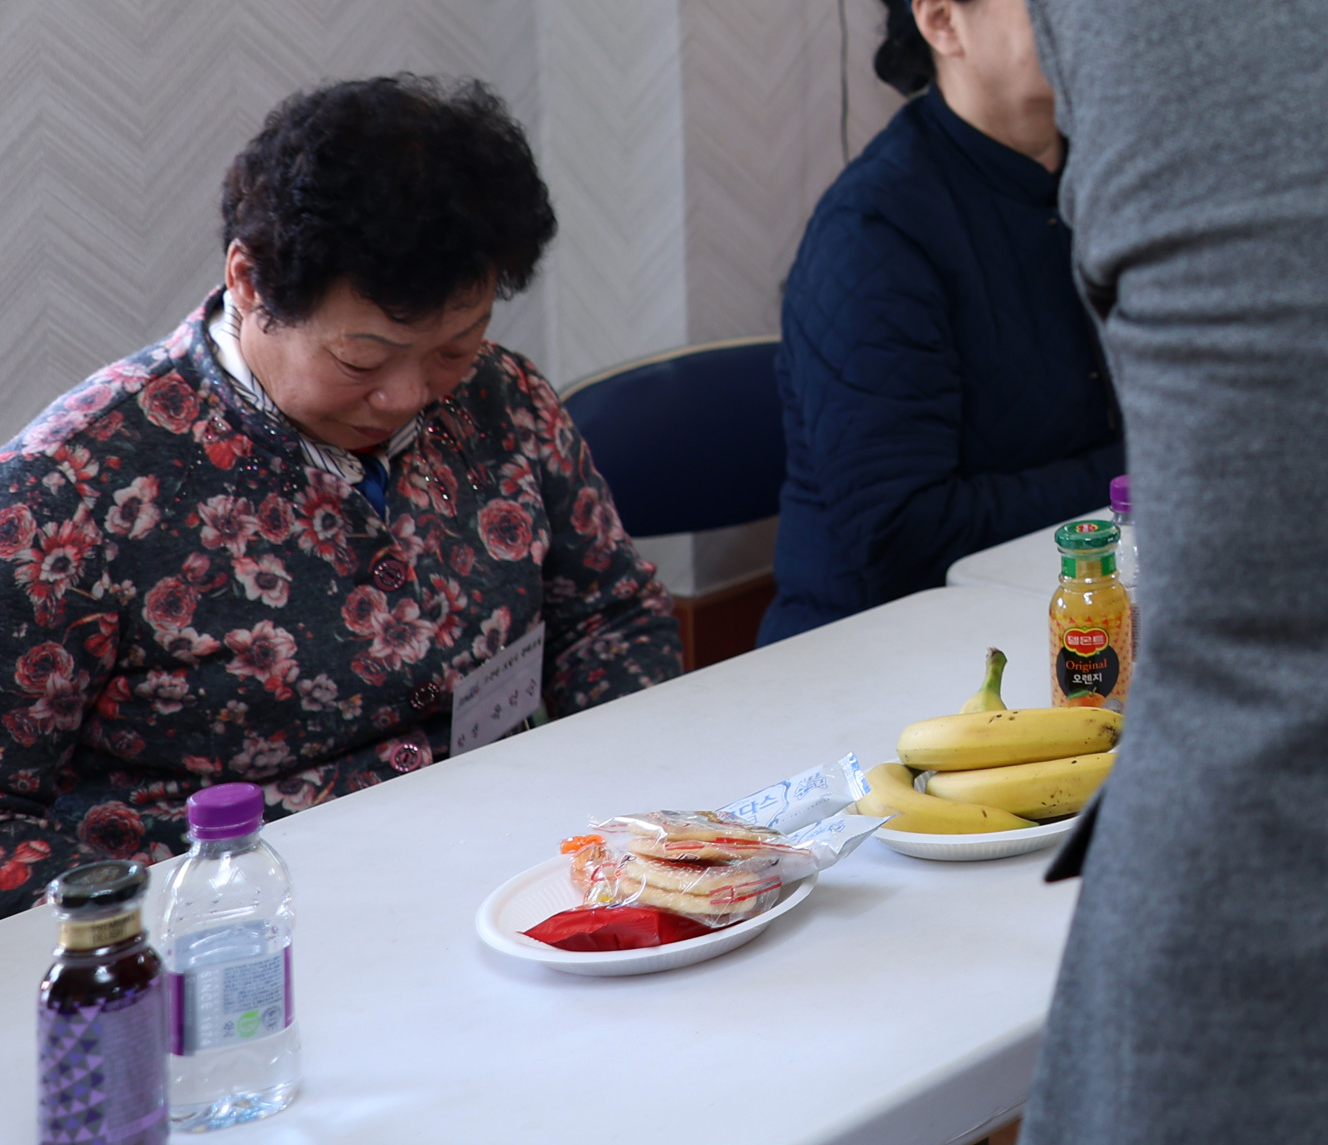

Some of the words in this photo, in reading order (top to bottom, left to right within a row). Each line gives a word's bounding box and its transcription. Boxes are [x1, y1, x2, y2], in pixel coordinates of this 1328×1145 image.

[1067, 635, 1105, 645] 델몬트
[1066, 659, 1107, 672] Original
[1073, 672, 1103, 684] 오렌지
[200, 970, 212, 1010] SINCE
